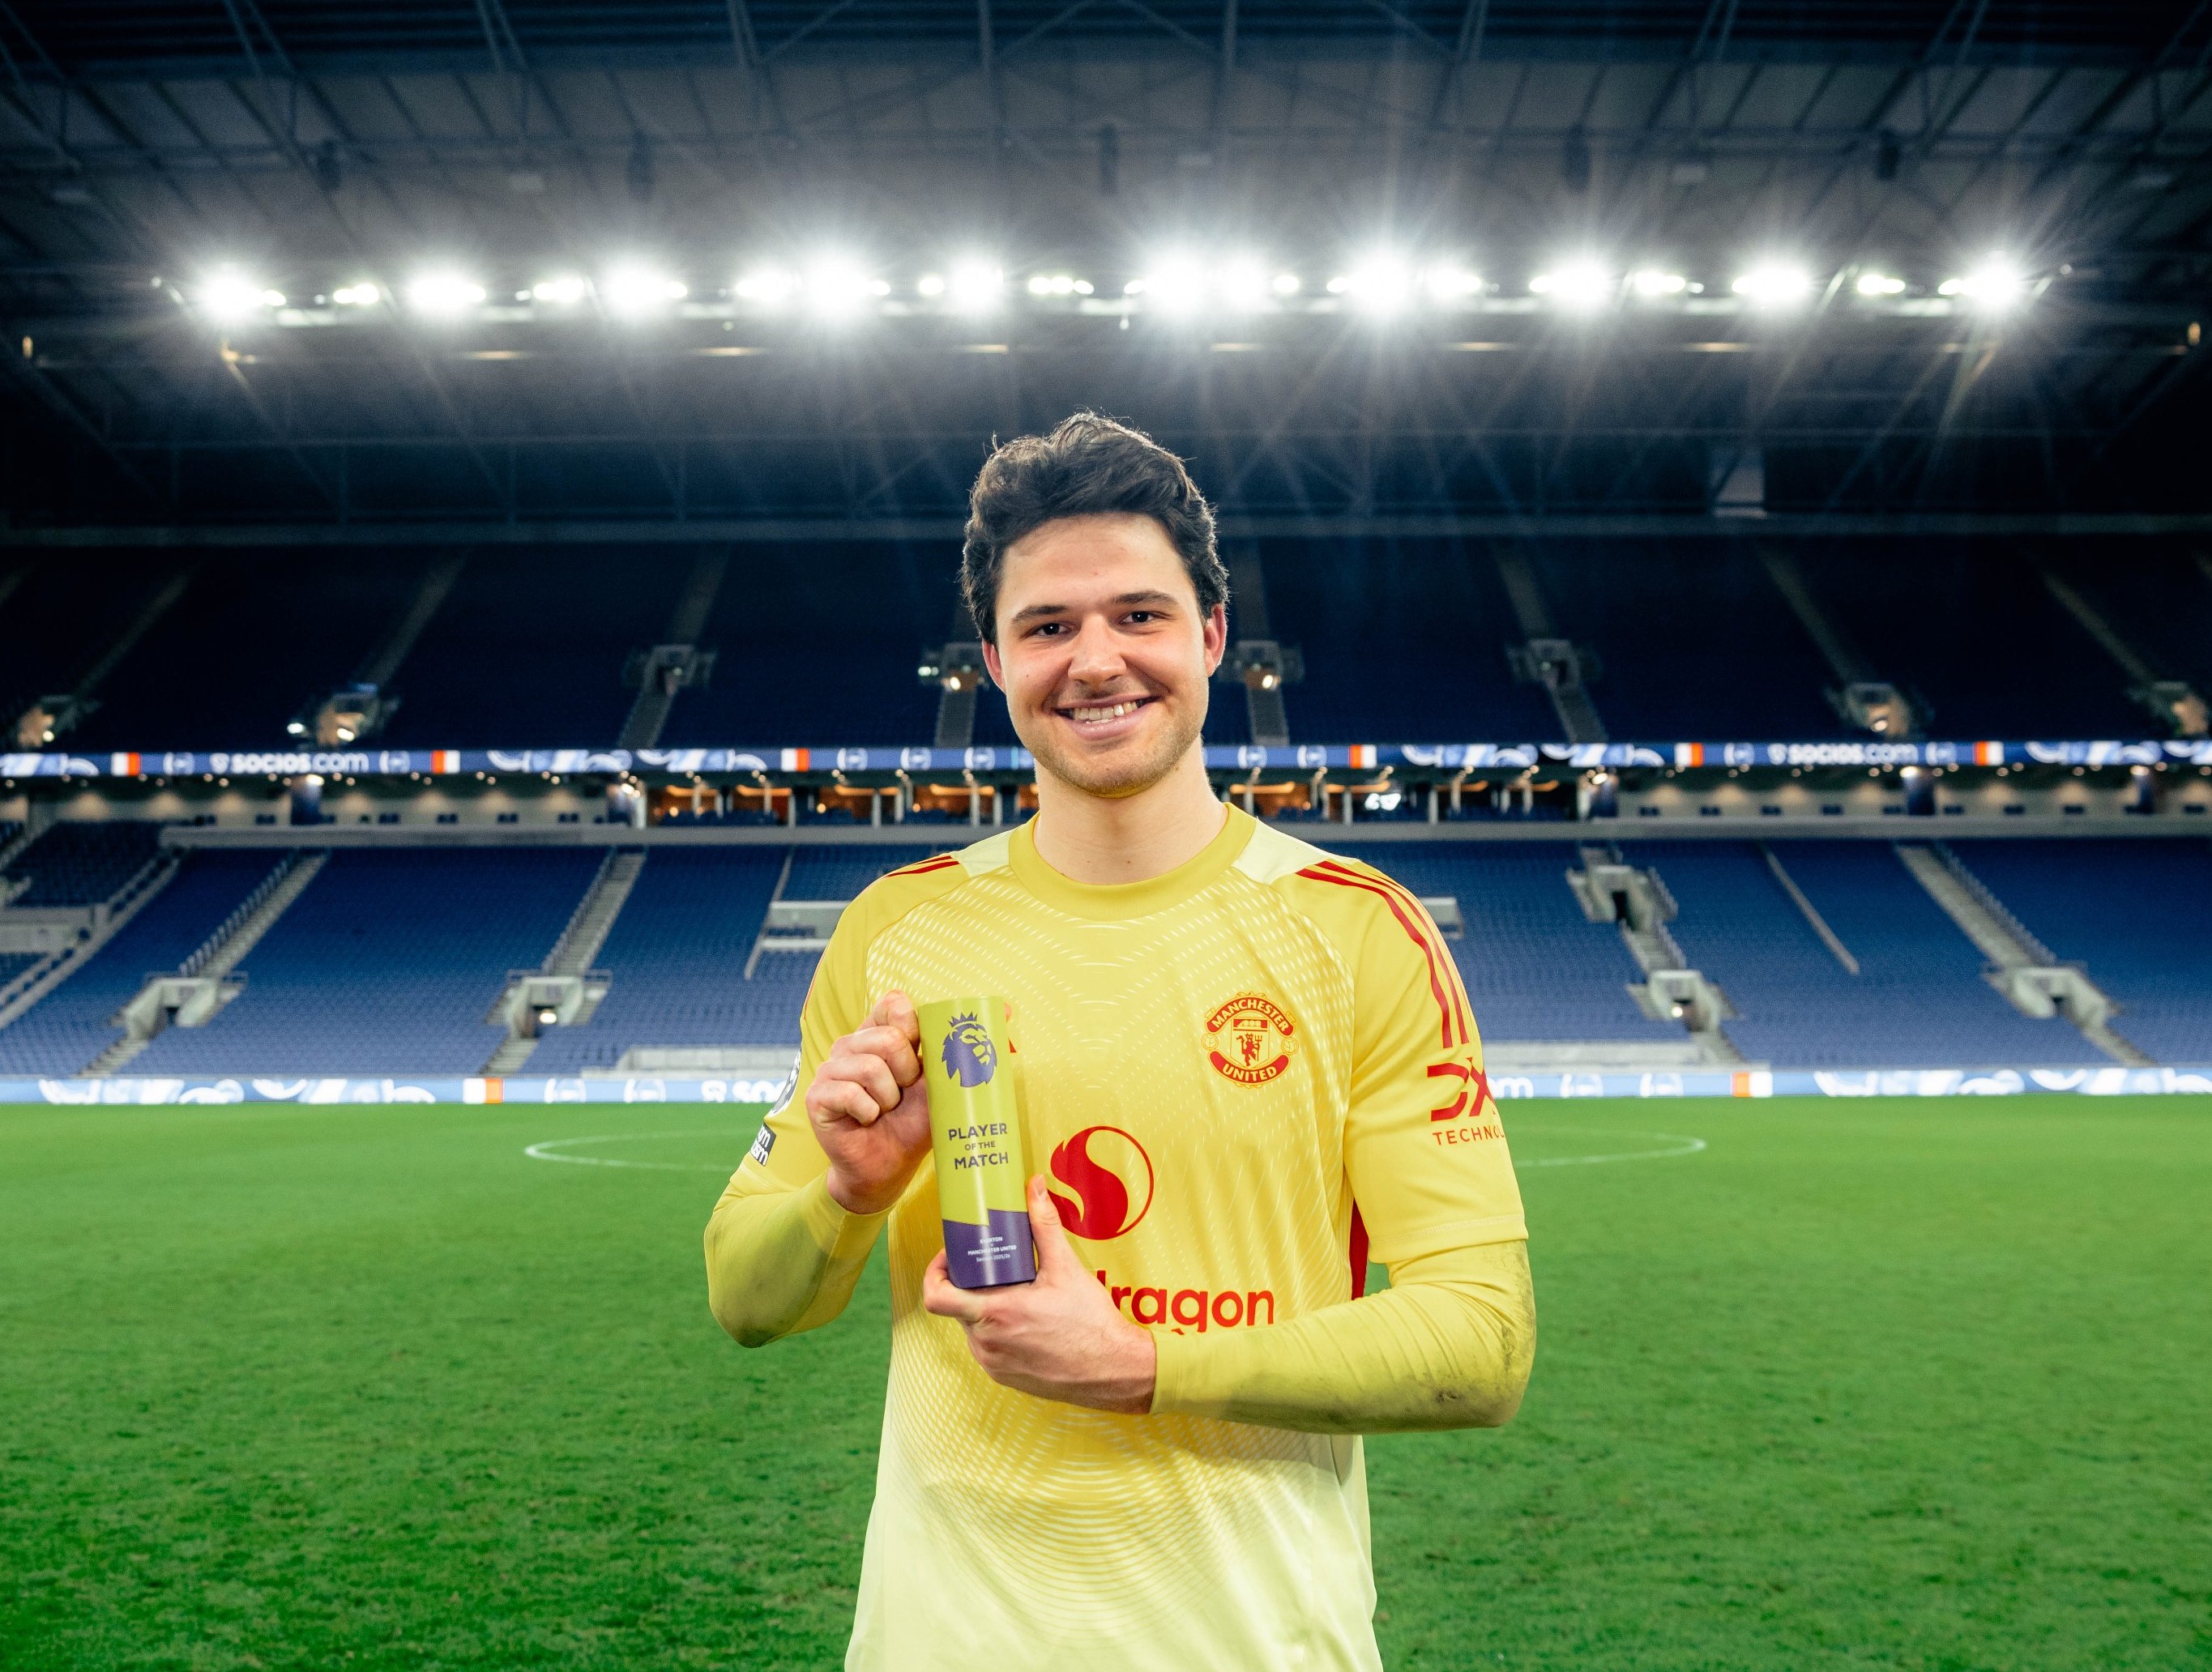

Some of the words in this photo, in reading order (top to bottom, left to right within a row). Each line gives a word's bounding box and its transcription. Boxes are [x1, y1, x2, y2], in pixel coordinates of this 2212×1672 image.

[1211, 999, 1290, 1032] MANCHESTER
[1222, 1063, 1277, 1082] UNITED
[948, 1123, 1008, 1141] PLAYER
[964, 1143, 976, 1151] OF
[978, 1141, 996, 1150] THE
[954, 1151, 1009, 1171] MATCH
